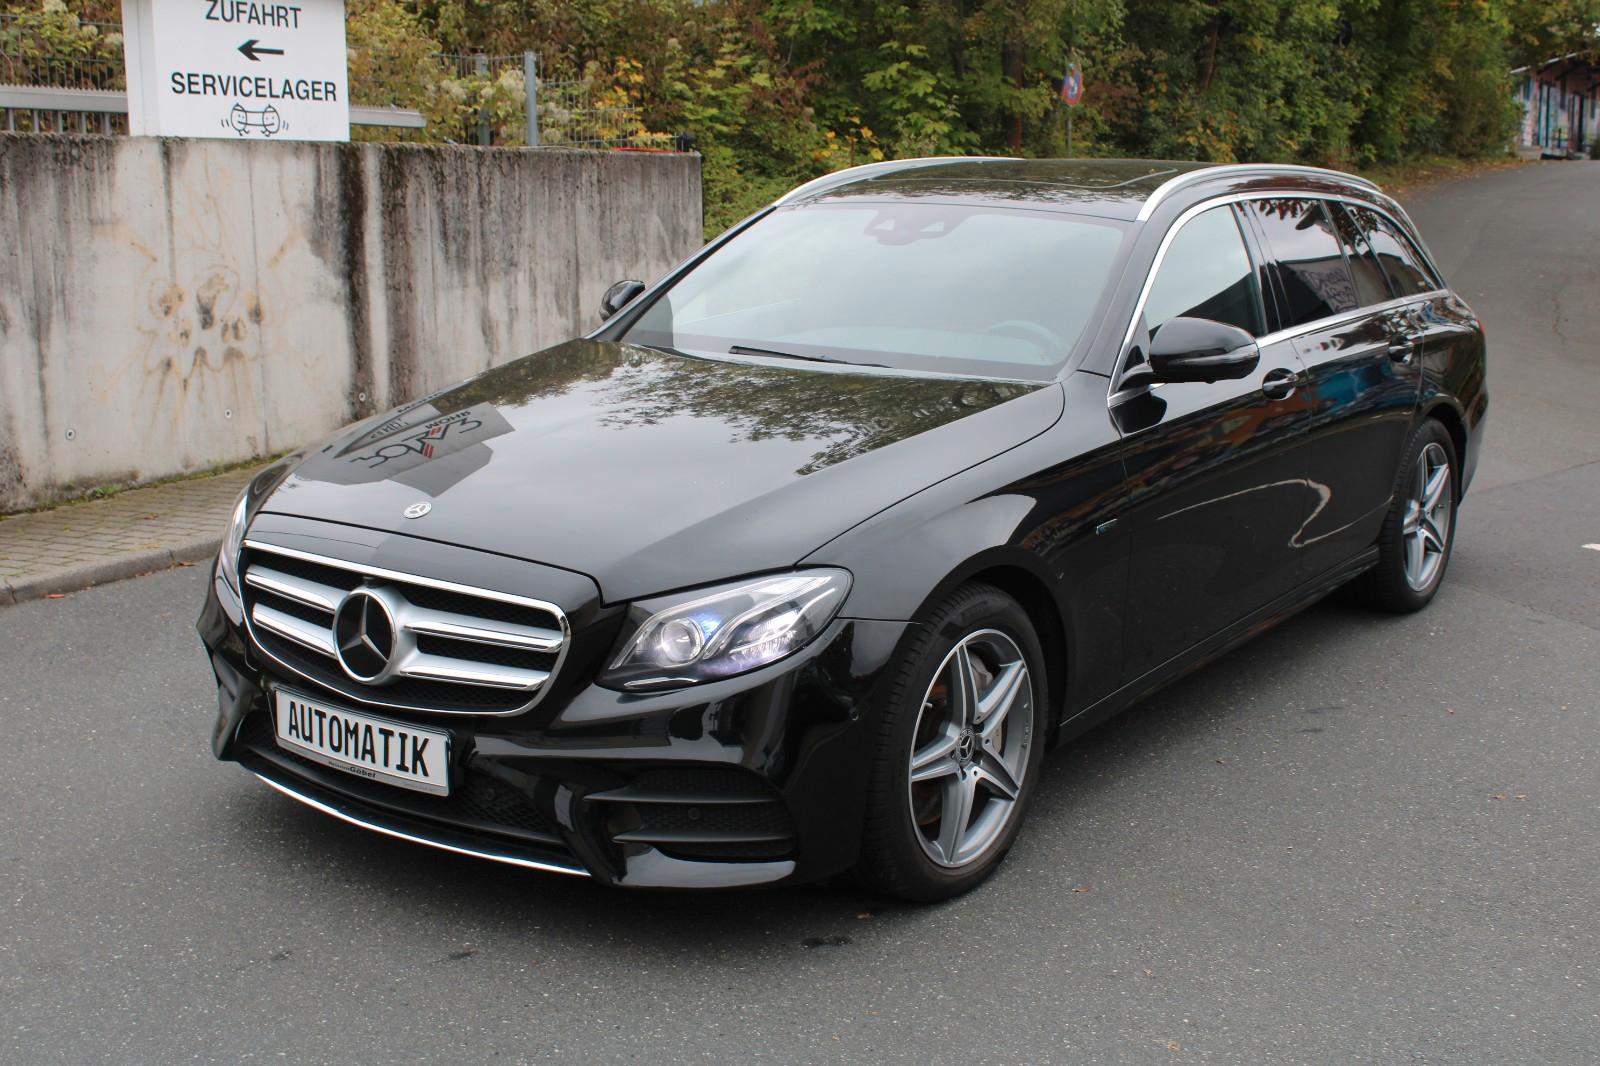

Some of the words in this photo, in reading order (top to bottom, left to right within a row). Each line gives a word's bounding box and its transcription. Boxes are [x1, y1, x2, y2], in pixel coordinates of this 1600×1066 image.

[206, 0, 301, 28] ZUFAHRT
[171, 72, 337, 101] SERVICELAGER
[288, 700, 430, 777] AUTOMATIK
